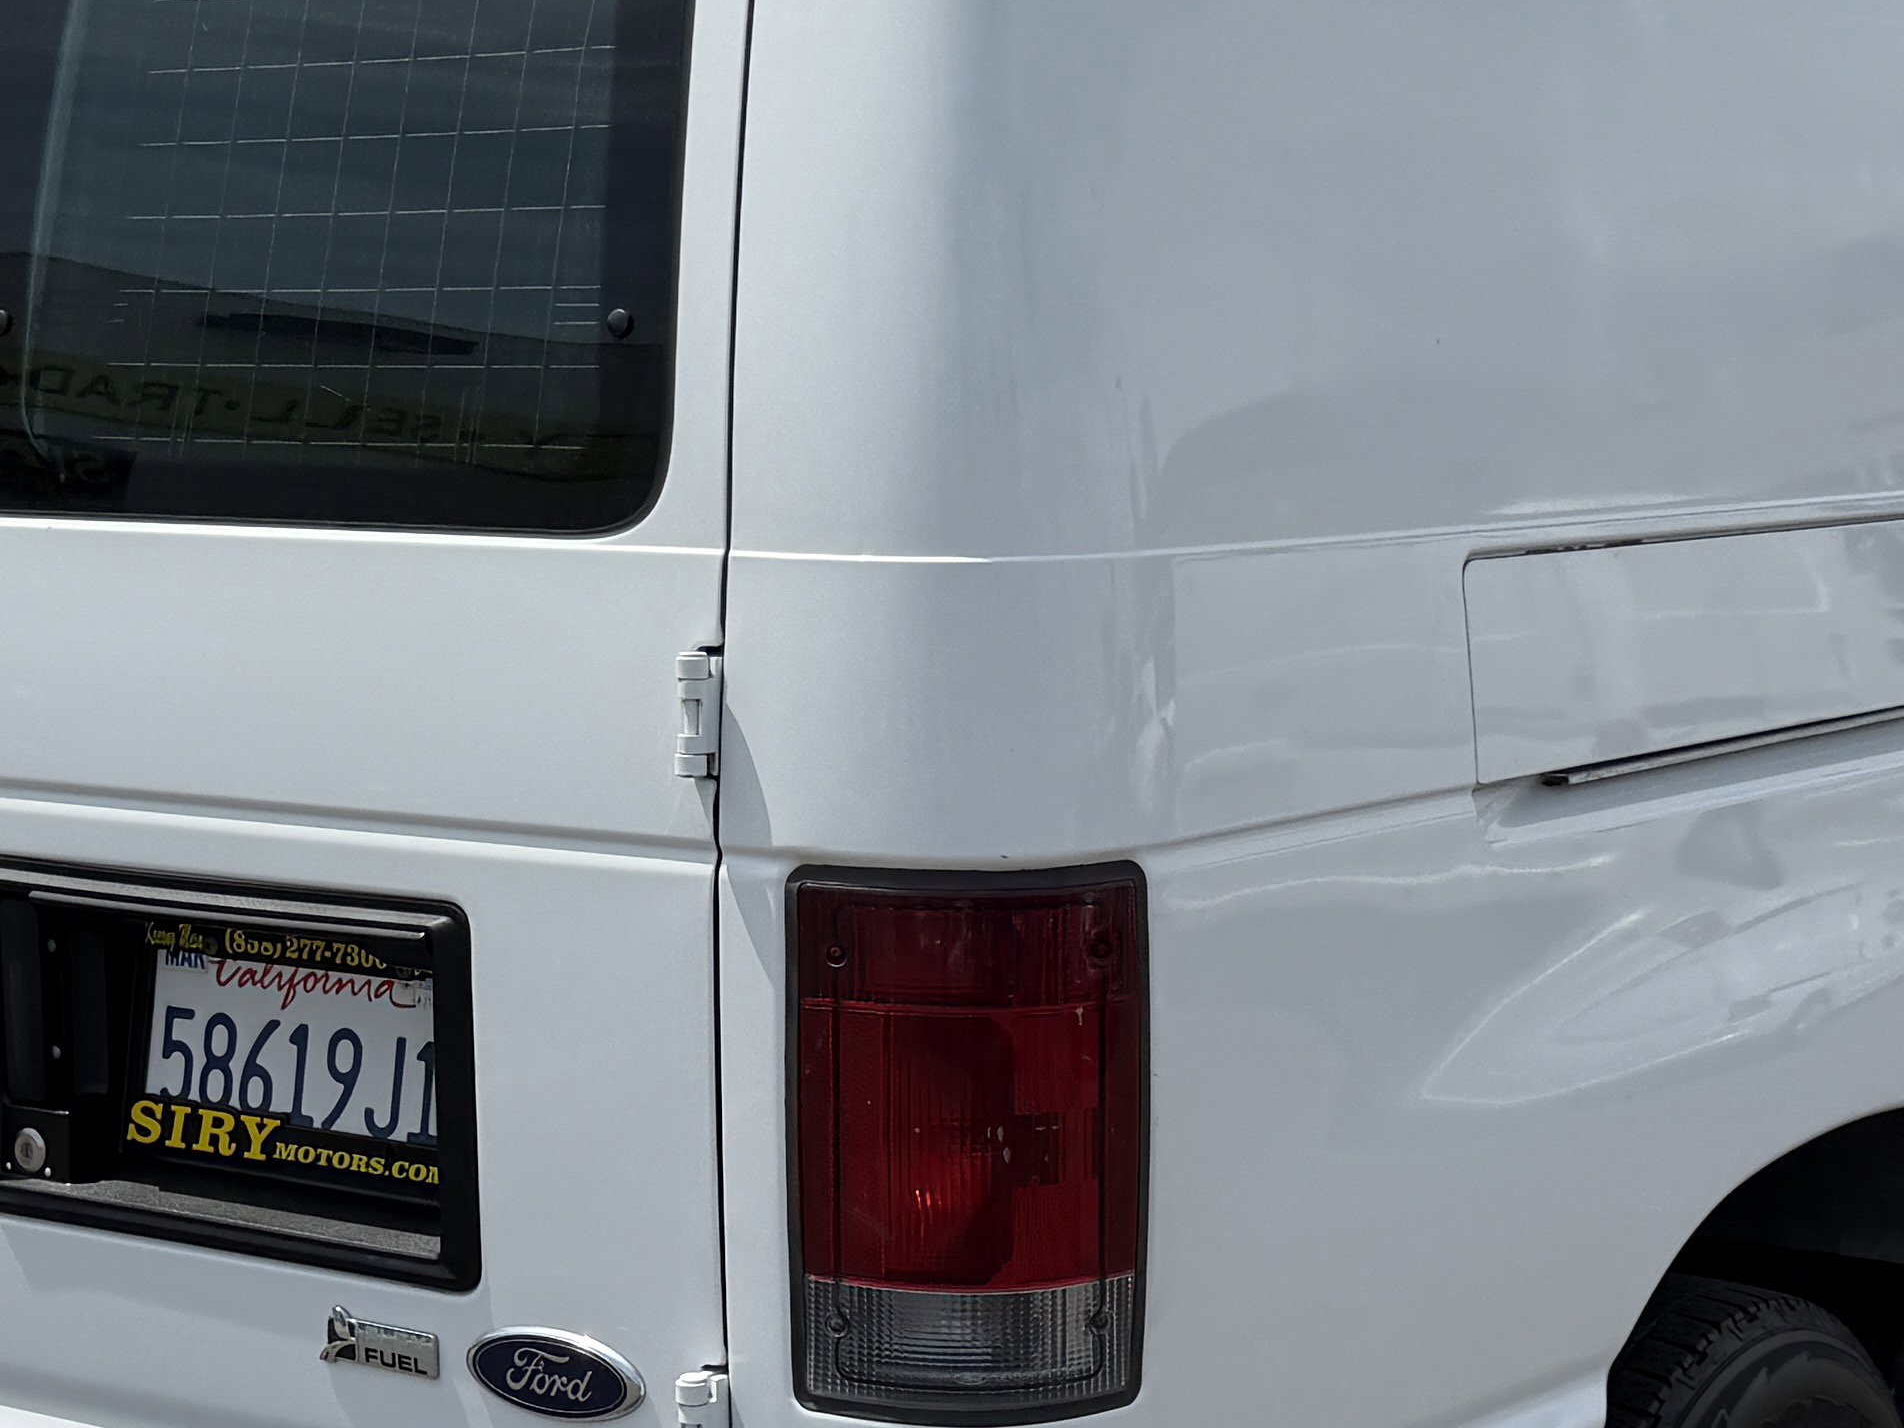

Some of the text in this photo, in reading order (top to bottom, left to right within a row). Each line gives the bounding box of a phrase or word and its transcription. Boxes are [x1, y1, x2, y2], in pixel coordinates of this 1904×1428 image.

[209, 956, 417, 1011] California
[159, 1005, 437, 1146] 58619J1
[126, 1099, 282, 1162] SIRY
[364, 1346, 428, 1376] FUEL
[505, 1346, 593, 1403] Ford
